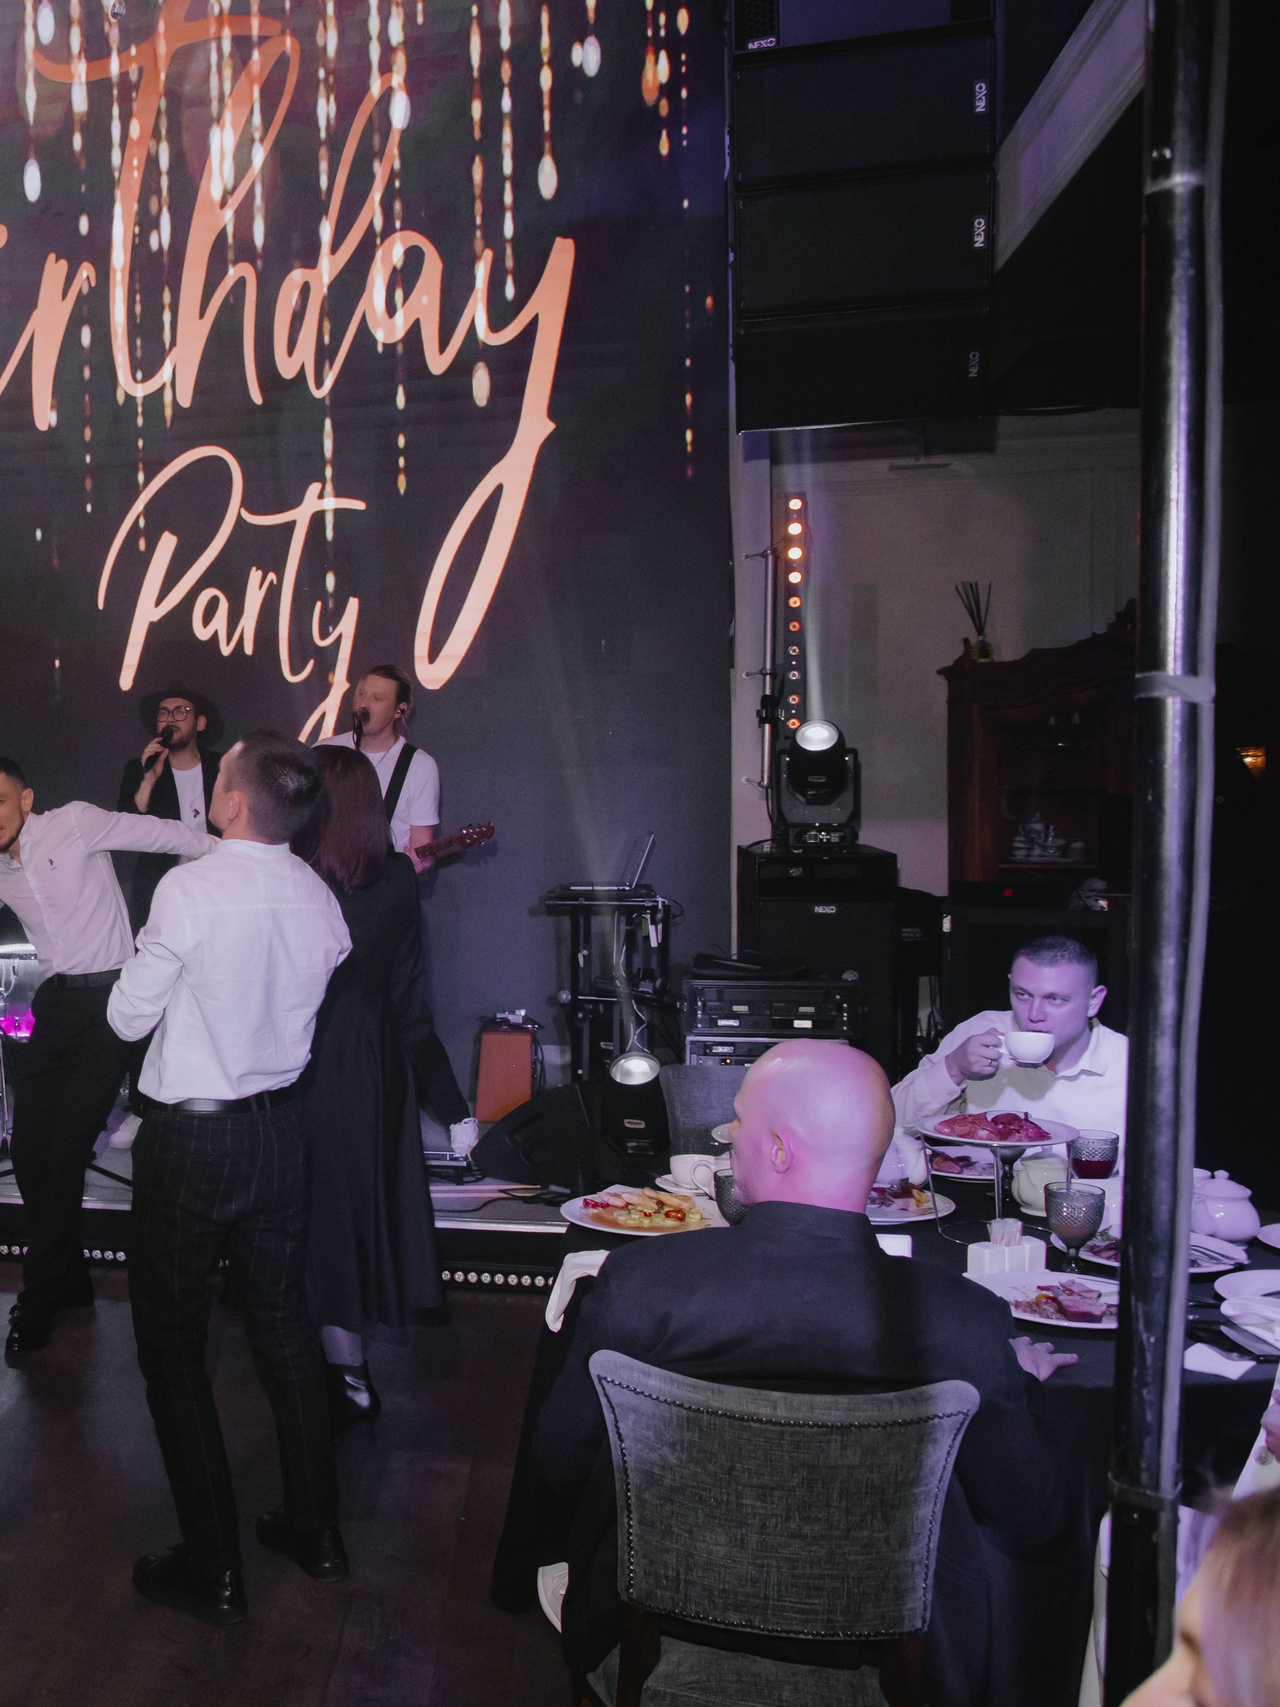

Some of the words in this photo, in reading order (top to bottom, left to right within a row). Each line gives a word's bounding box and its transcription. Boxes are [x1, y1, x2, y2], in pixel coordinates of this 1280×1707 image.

[975, 82, 986, 112] NEXO
[974, 218, 985, 247] NEXO
[968, 351, 979, 378] NEXO
[97, 445, 367, 743] Party
[814, 905, 836, 913] NEXO
